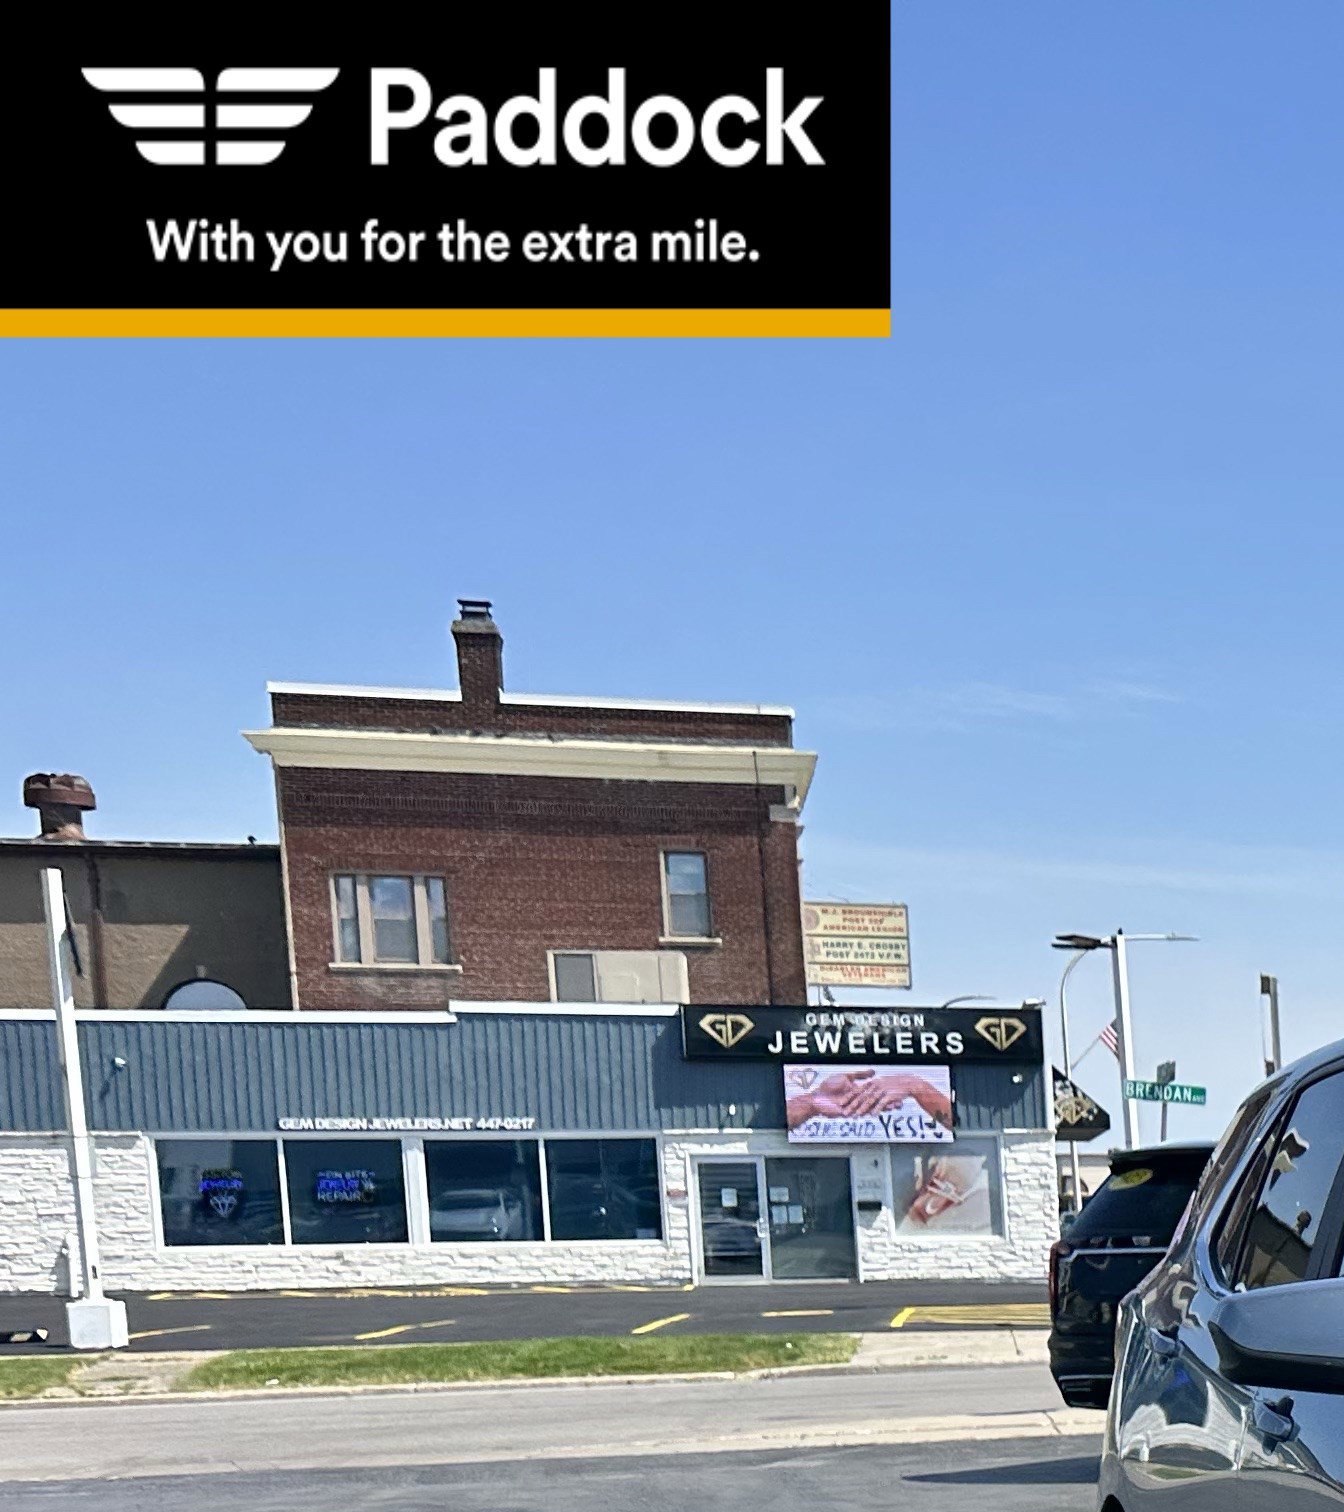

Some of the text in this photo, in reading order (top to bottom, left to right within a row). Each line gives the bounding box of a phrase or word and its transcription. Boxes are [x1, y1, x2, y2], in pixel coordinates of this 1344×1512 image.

[805, 1012, 925, 1027] GEM DESIGN
[767, 1030, 965, 1055] JEWELERS
[1126, 1081, 1192, 1102] BRENDAN
[878, 1114, 926, 1139] YES!
